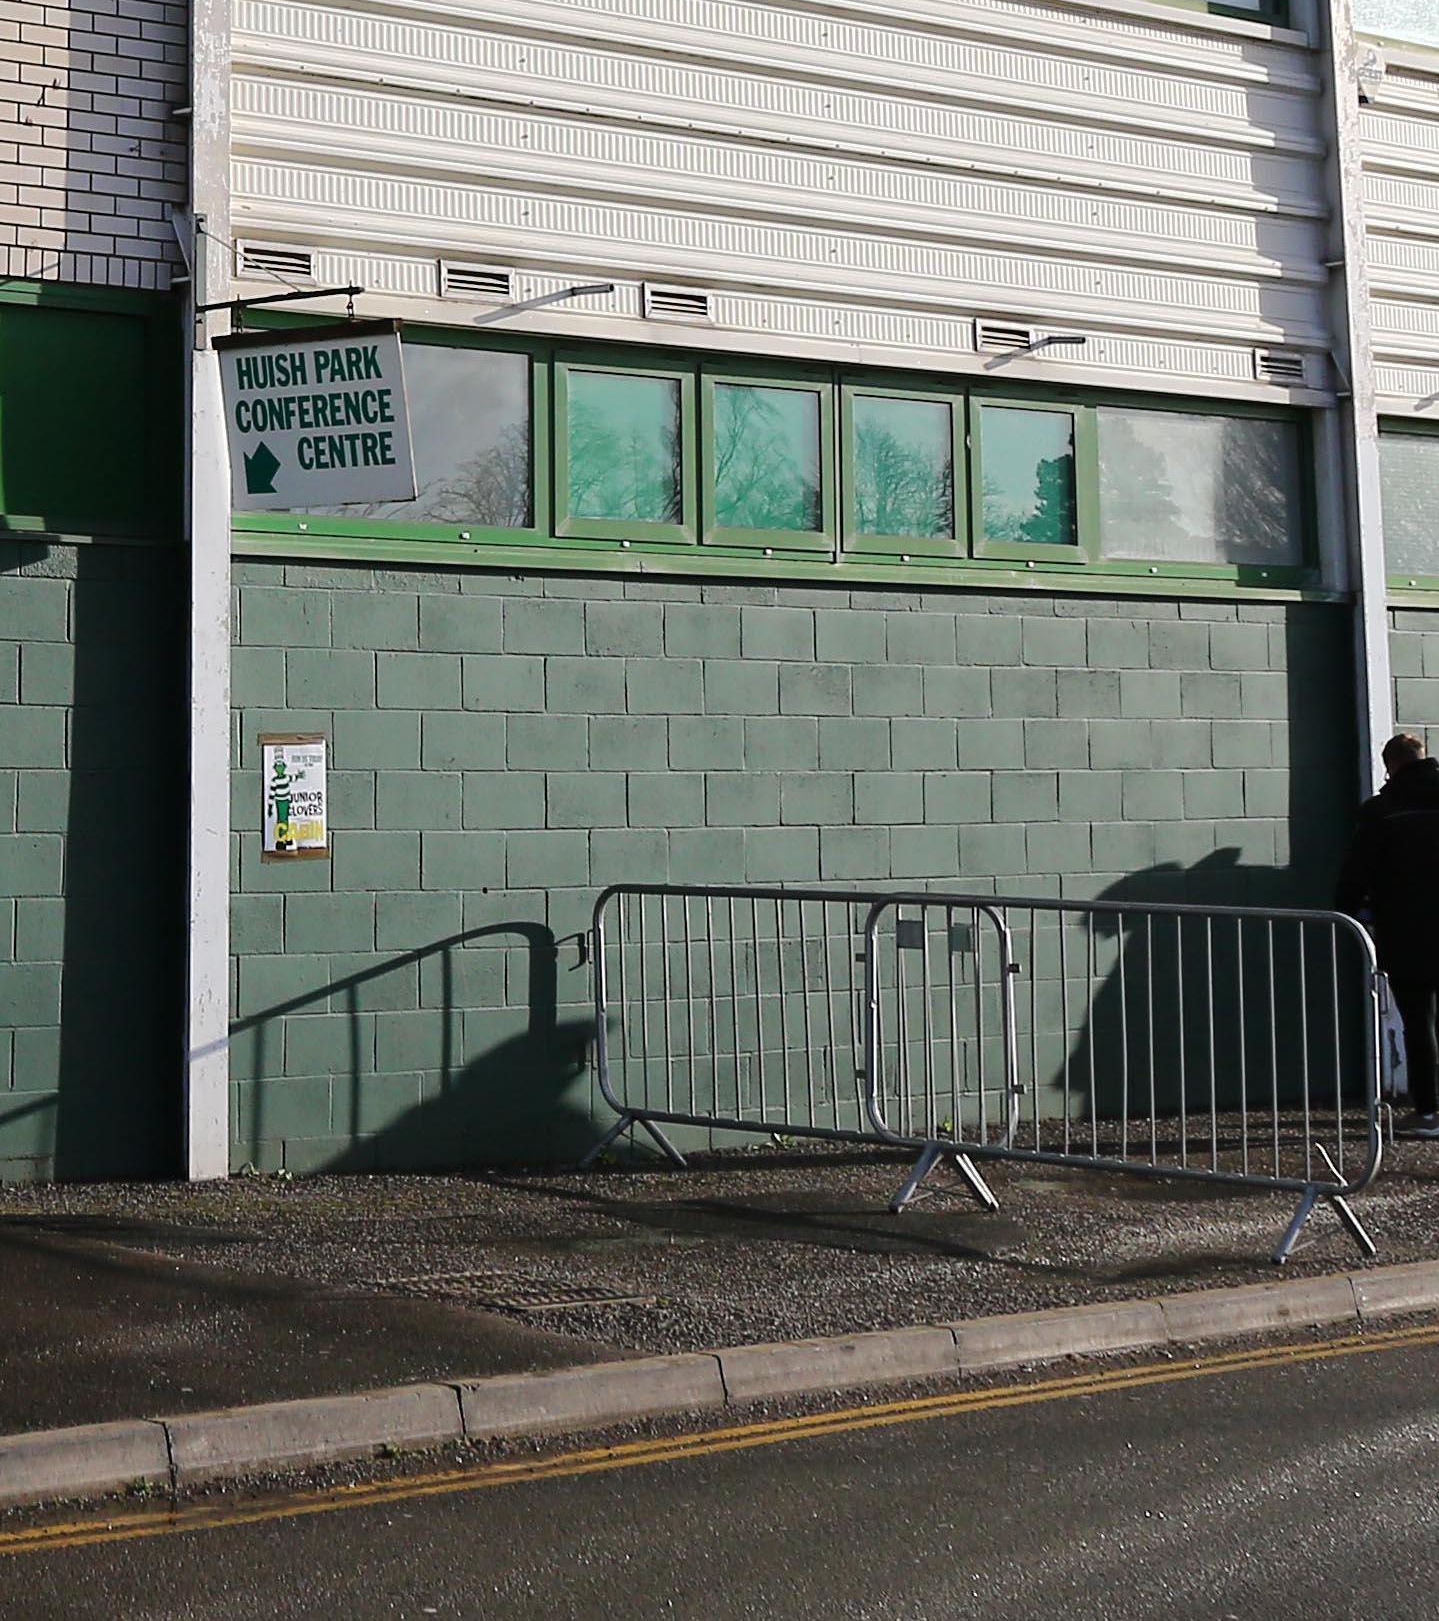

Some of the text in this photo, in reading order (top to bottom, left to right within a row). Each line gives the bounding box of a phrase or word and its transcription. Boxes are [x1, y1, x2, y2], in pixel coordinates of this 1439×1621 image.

[236, 345, 383, 390] HUISH PARK
[235, 388, 396, 433] CONFERENCE
[297, 431, 397, 470] CENTRE
[289, 791, 324, 806] JUNIOR
